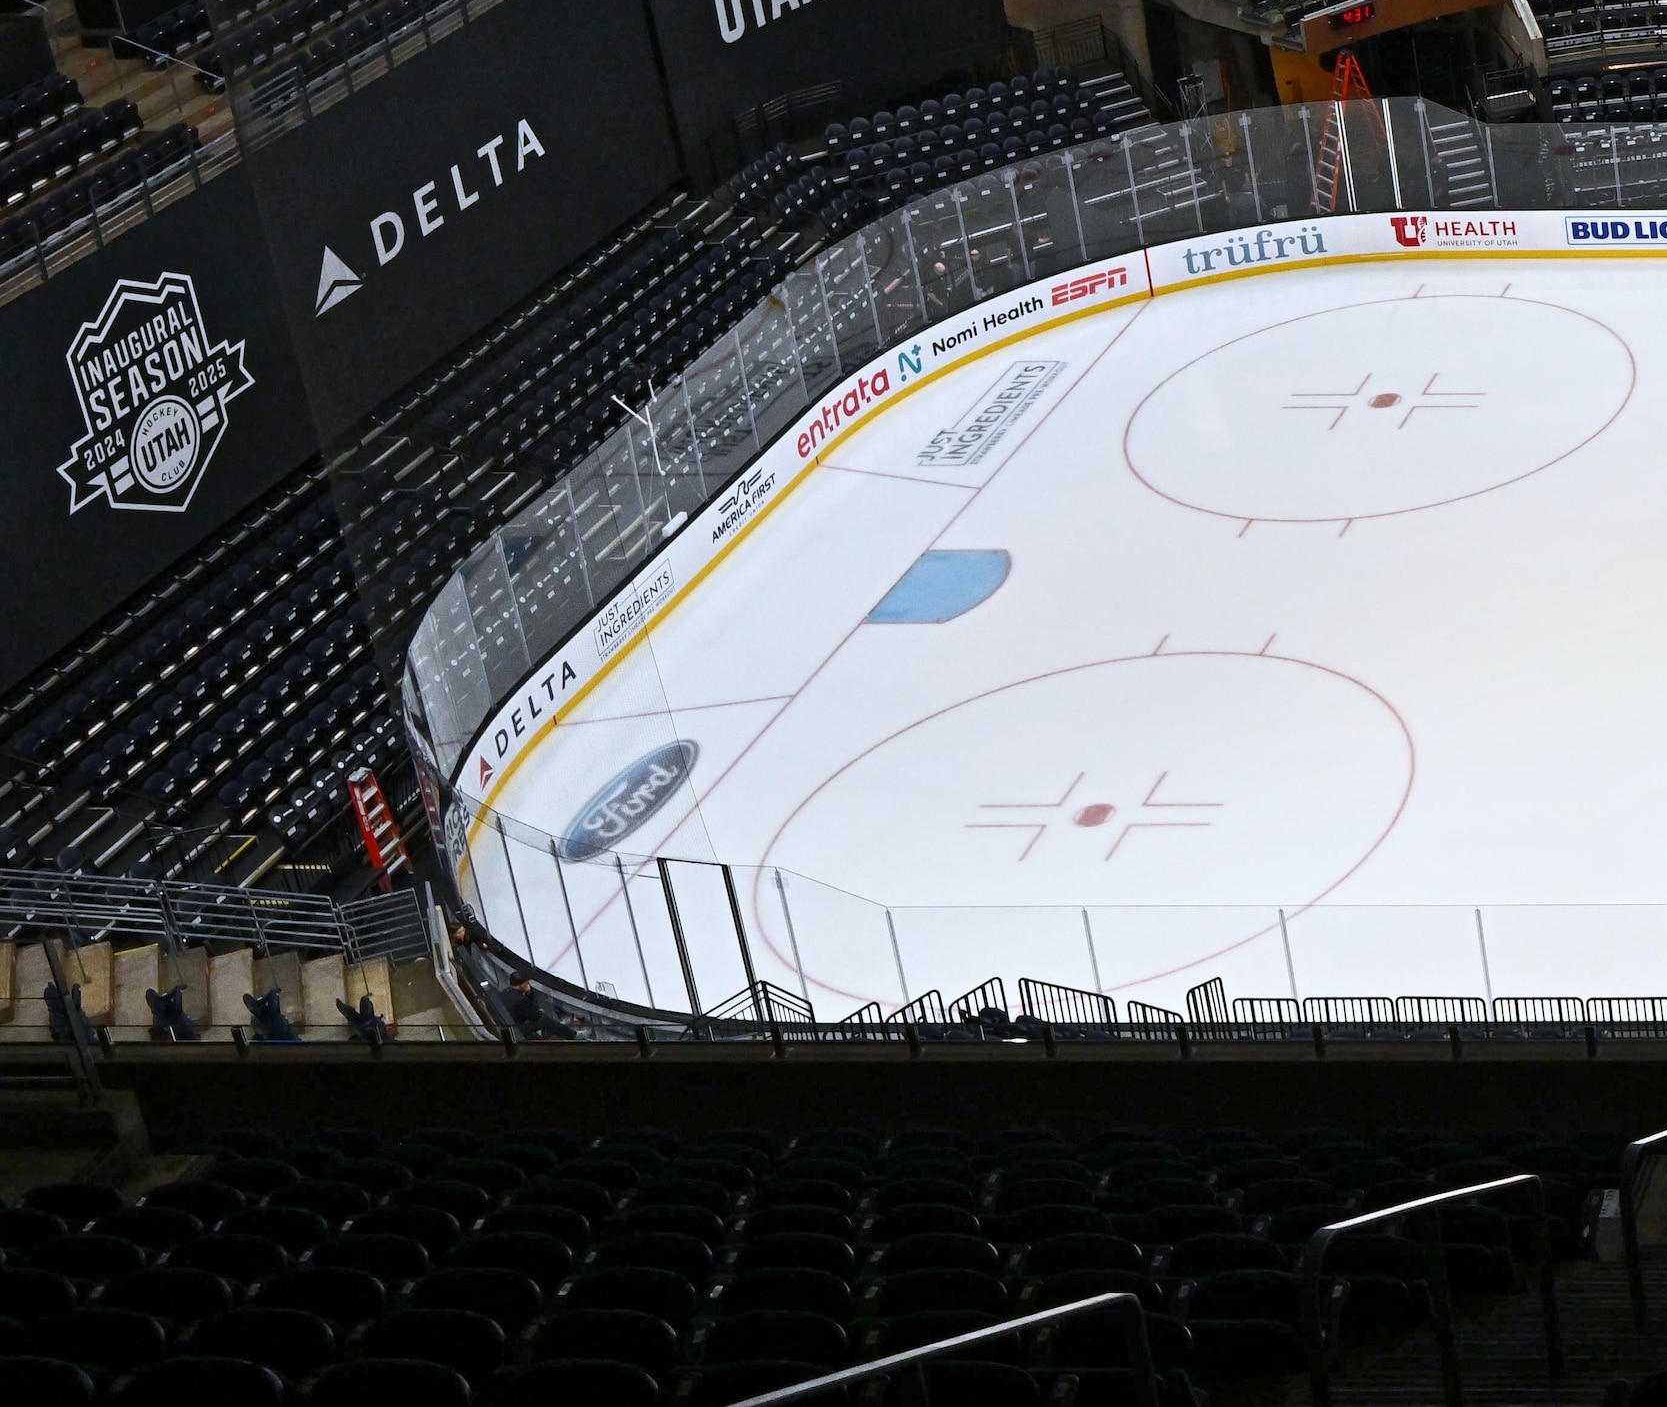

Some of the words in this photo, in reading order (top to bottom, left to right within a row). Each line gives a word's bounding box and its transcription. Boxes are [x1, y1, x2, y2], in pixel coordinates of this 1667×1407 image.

[369, 118, 545, 267] DELTA
[1182, 226, 1327, 274] trüfrü
[1435, 221, 1517, 237] HEALTH
[1437, 239, 1482, 247] UNIVERSITY
[1496, 238, 1518, 246] UTAH
[1572, 221, 1637, 240] BUD
[1051, 267, 1127, 307] ESPN
[79, 301, 193, 391] INAUGURAL
[931, 322, 979, 356] Nomi
[983, 296, 1044, 332] Health
[89, 325, 204, 432] SEASON
[188, 357, 226, 397] 2025
[142, 407, 179, 436] HOCKEY
[797, 368, 890, 458] entrata
[941, 364, 1046, 460] INGREDIENTS
[83, 428, 126, 472] 2024
[140, 418, 192, 473] UTAH
[917, 428, 958, 461] JUST
[161, 460, 186, 482] CLUB
[712, 499, 752, 544] AMERICA
[752, 473, 777, 505] FIRST
[597, 602, 620, 632] JUST
[599, 570, 670, 646] INGREDIENTS
[494, 660, 577, 759] DELTA
[585, 764, 679, 839] Ford
